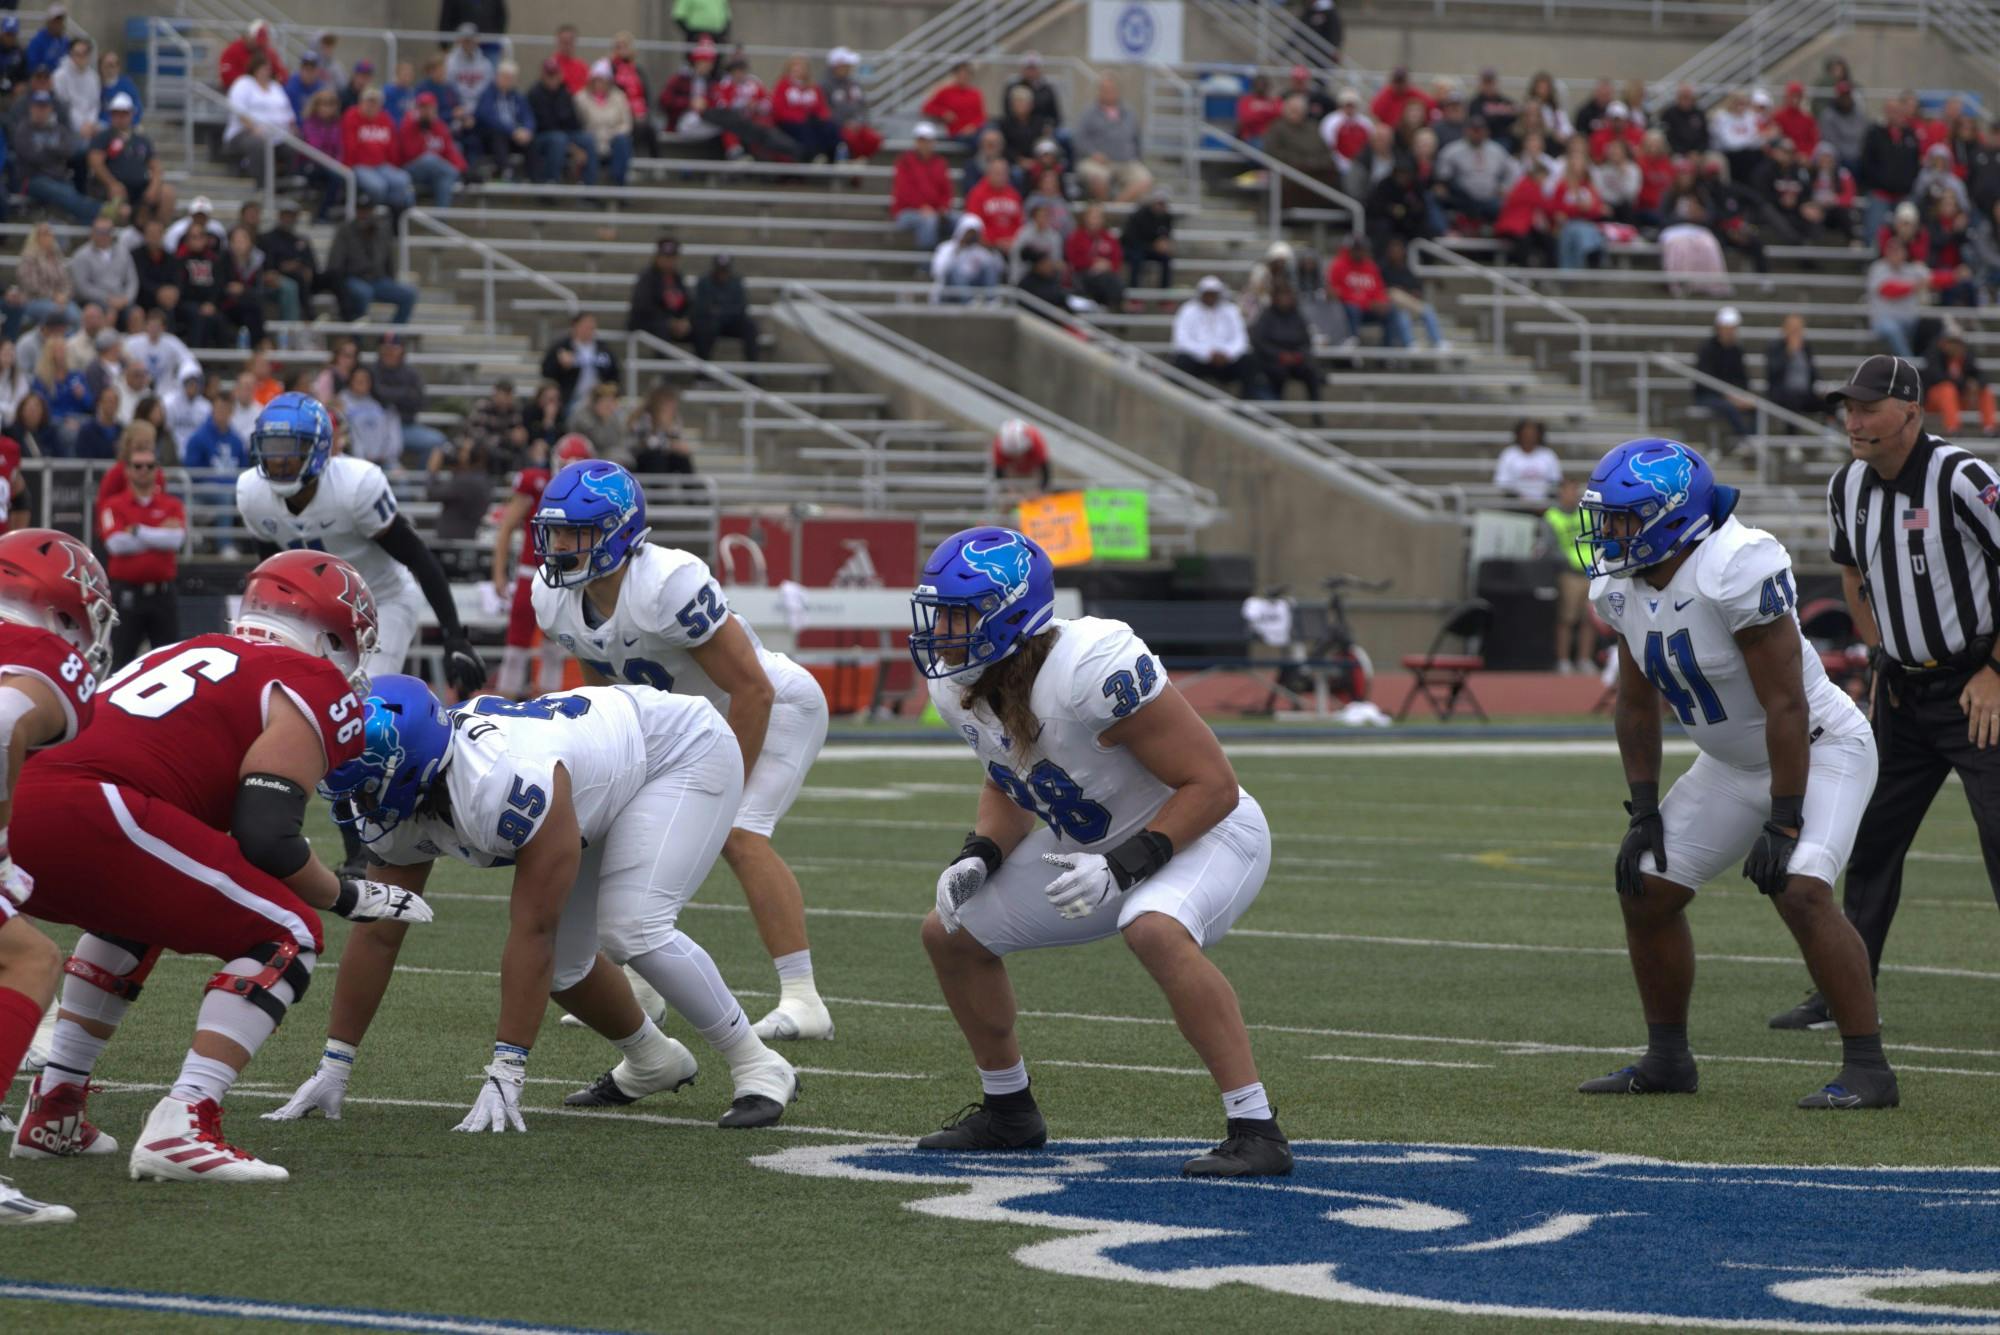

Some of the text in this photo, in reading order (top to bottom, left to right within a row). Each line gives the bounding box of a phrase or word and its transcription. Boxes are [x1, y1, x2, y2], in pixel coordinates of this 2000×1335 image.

[373, 488, 396, 522] 11
[1857, 509, 1866, 525] S
[1911, 554, 1926, 575] U
[675, 584, 726, 639] 52
[1758, 568, 1794, 616] 41
[60, 653, 96, 703] 89
[1102, 653, 1158, 718] 38
[1644, 627, 1728, 726] 41
[328, 692, 363, 744] 56
[497, 773, 547, 848] 85
[988, 758, 1113, 845] 38
